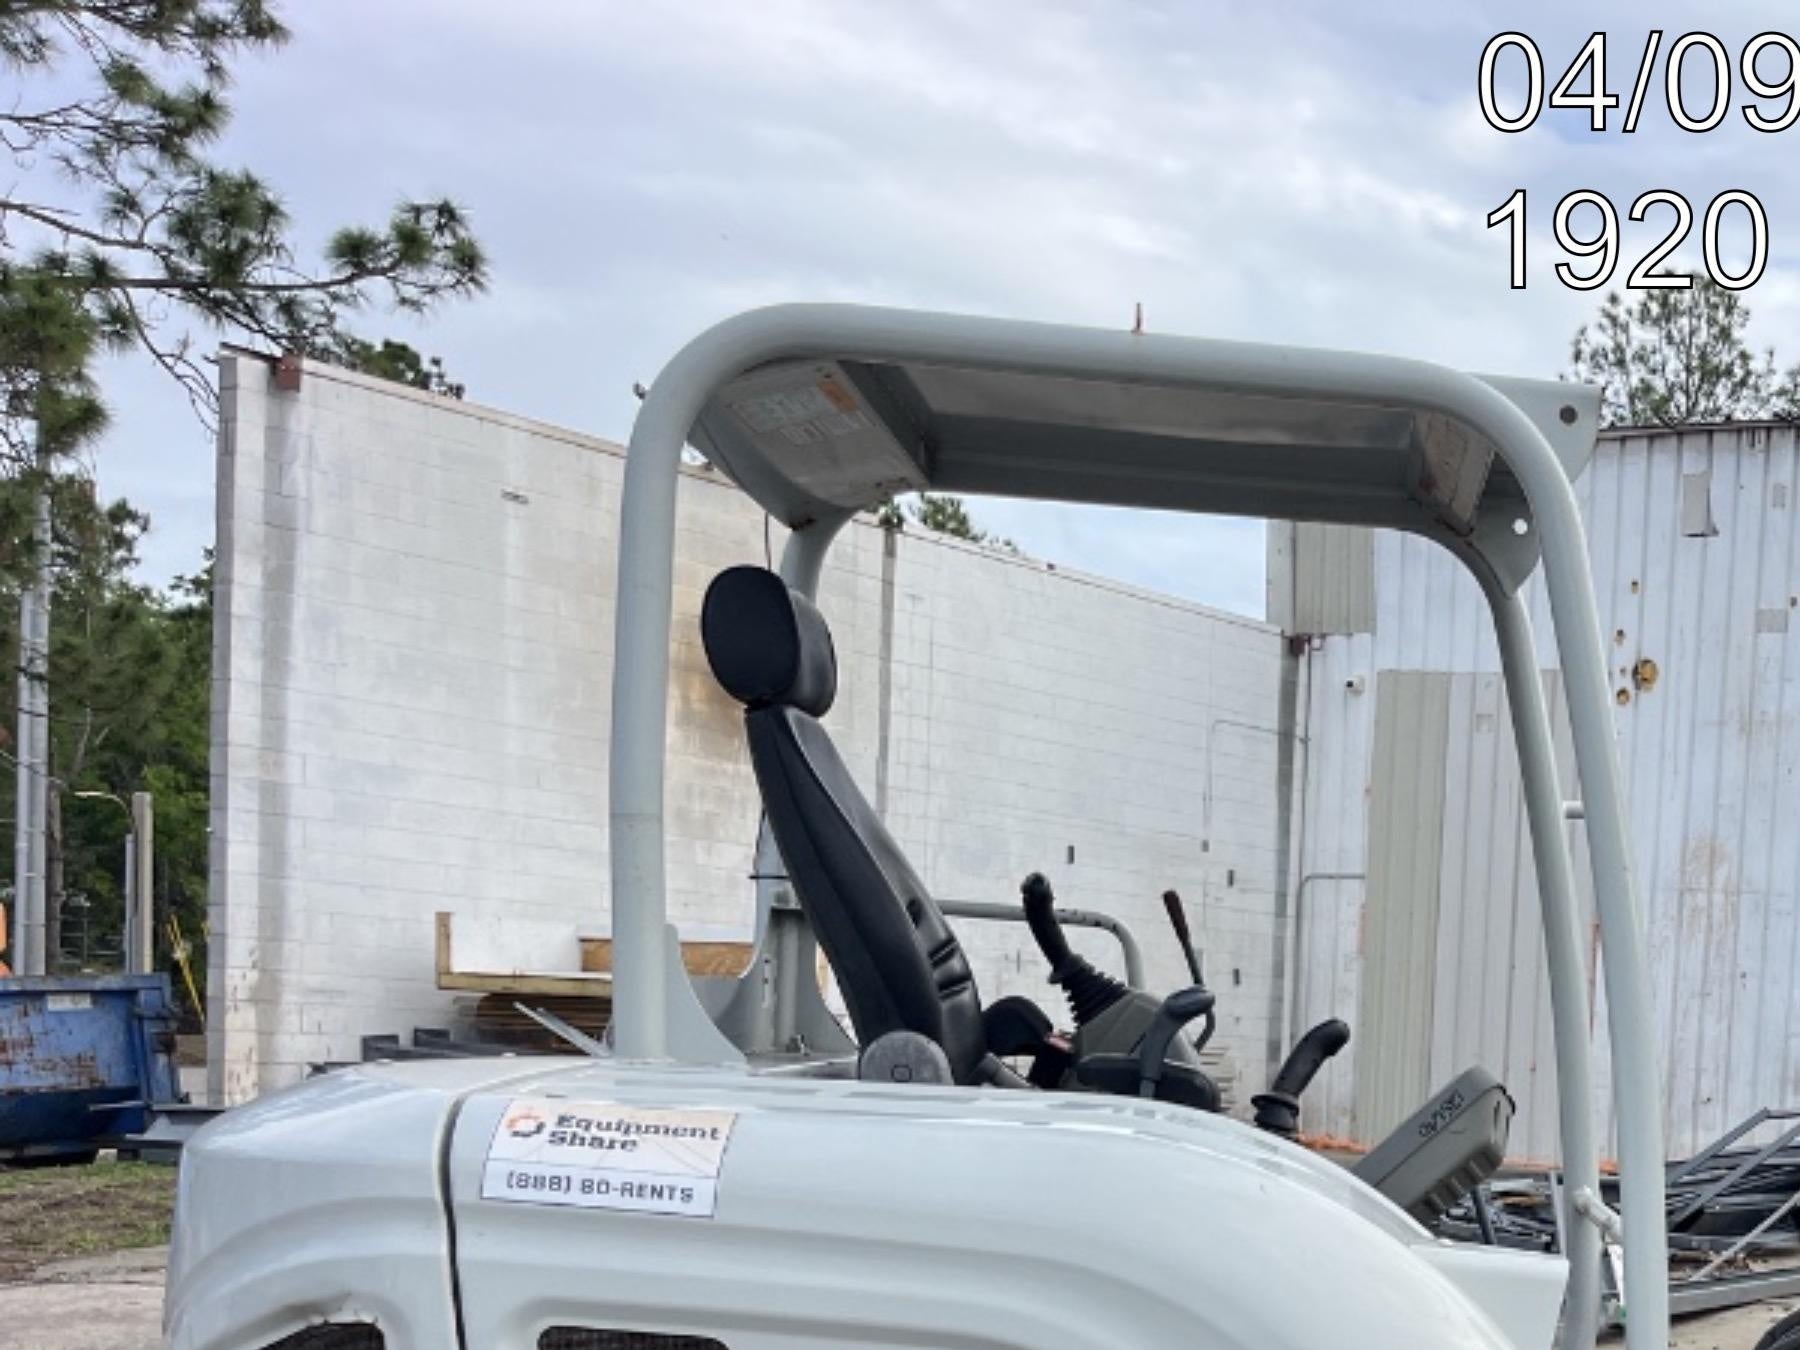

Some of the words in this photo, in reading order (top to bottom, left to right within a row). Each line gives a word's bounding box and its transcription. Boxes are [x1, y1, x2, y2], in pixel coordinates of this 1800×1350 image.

[554, 1113, 721, 1141] Equipment
[547, 1130, 640, 1152] Share
[506, 1170, 572, 1193] (888)
